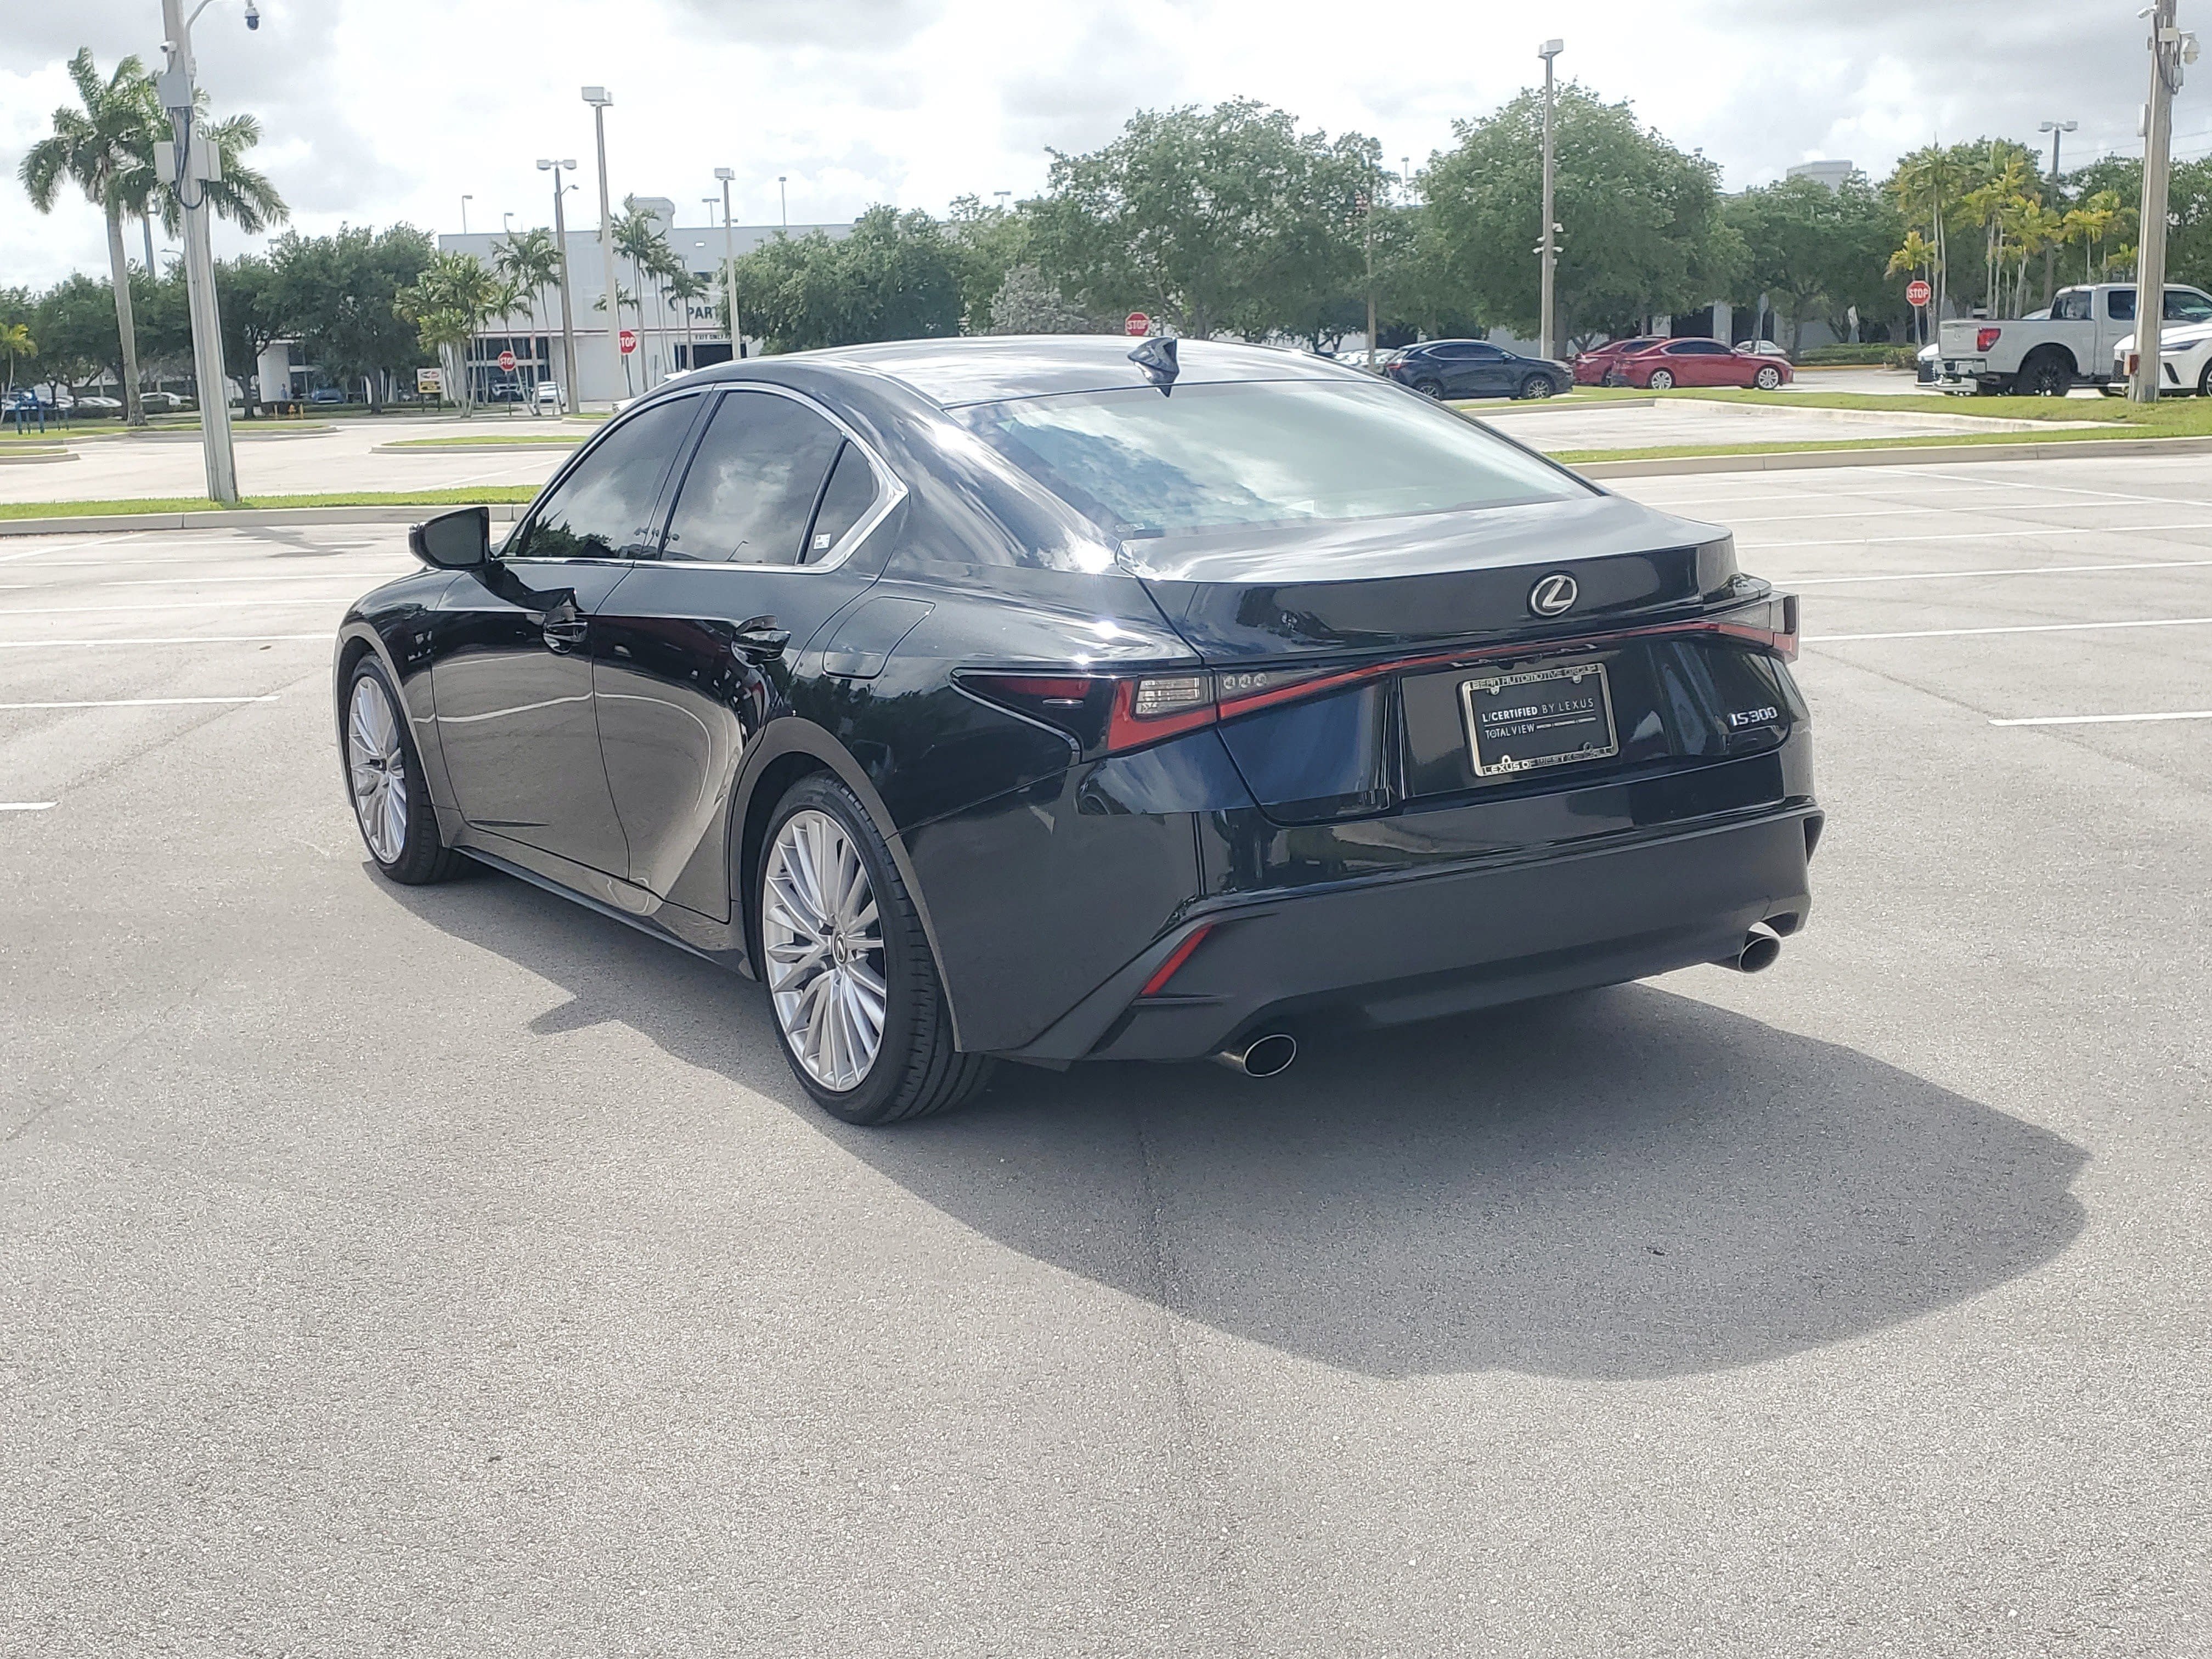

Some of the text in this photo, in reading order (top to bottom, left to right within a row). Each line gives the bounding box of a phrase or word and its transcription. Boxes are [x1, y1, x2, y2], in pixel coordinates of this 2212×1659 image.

[1909, 287, 1929, 298] STOP
[1127, 319, 1148, 330] STOP
[620, 336, 636, 348] TOP
[1502, 669, 1563, 685] AUTOMOTIVE
[1542, 703, 1556, 714] BY
[1559, 698, 1594, 712] LEXUS
[1485, 727, 1511, 740] TOTAL
[1513, 723, 1536, 735] VIEW
[1483, 761, 1520, 775] LEXUS
[1521, 759, 1536, 769] OF
